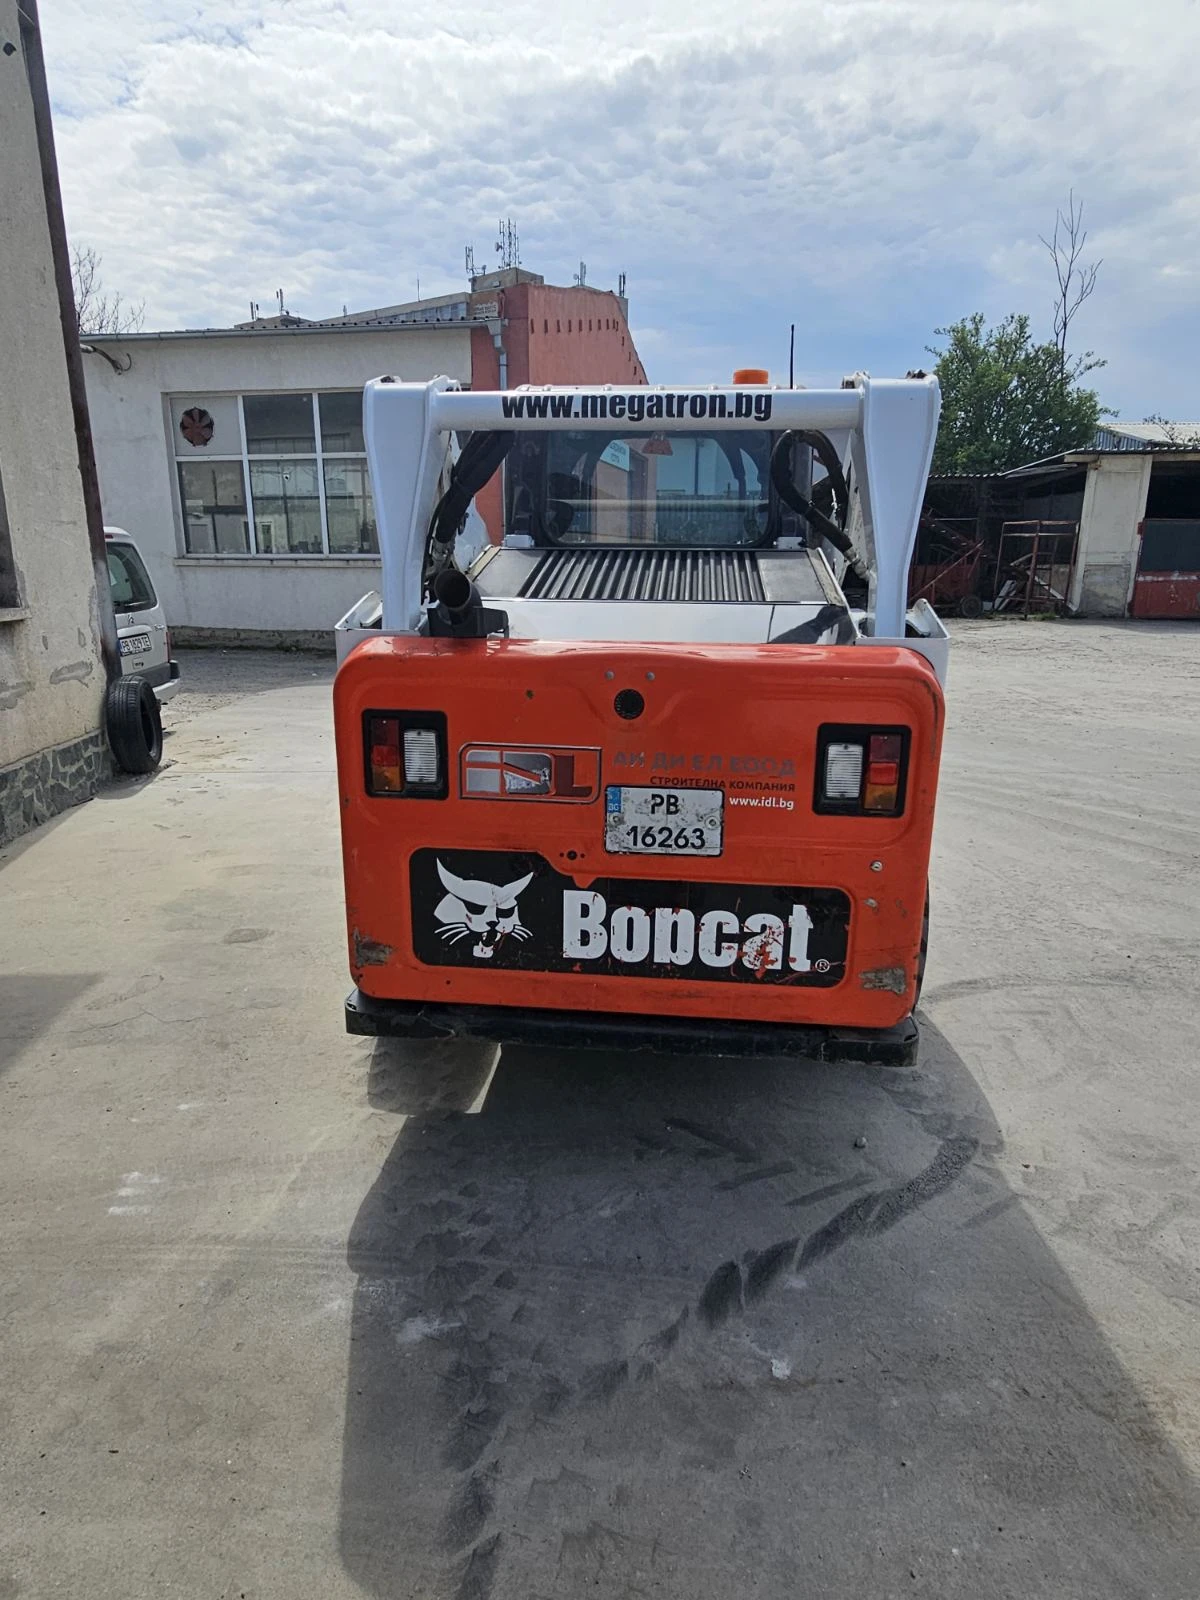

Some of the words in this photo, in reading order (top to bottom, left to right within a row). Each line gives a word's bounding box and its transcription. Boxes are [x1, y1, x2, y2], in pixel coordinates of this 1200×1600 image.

[502, 392, 773, 422] www.megatron.bg
[651, 752, 687, 771] ДИ
[692, 755, 723, 773] ЕЛ
[729, 757, 796, 776] ЕООД
[650, 776, 726, 789] СТРОИТЕЛНА
[729, 780, 796, 792] КОМПАНИЯ
[650, 794, 680, 816] PB
[729, 795, 794, 810] www.idl.bg
[626, 825, 705, 850] 16263
